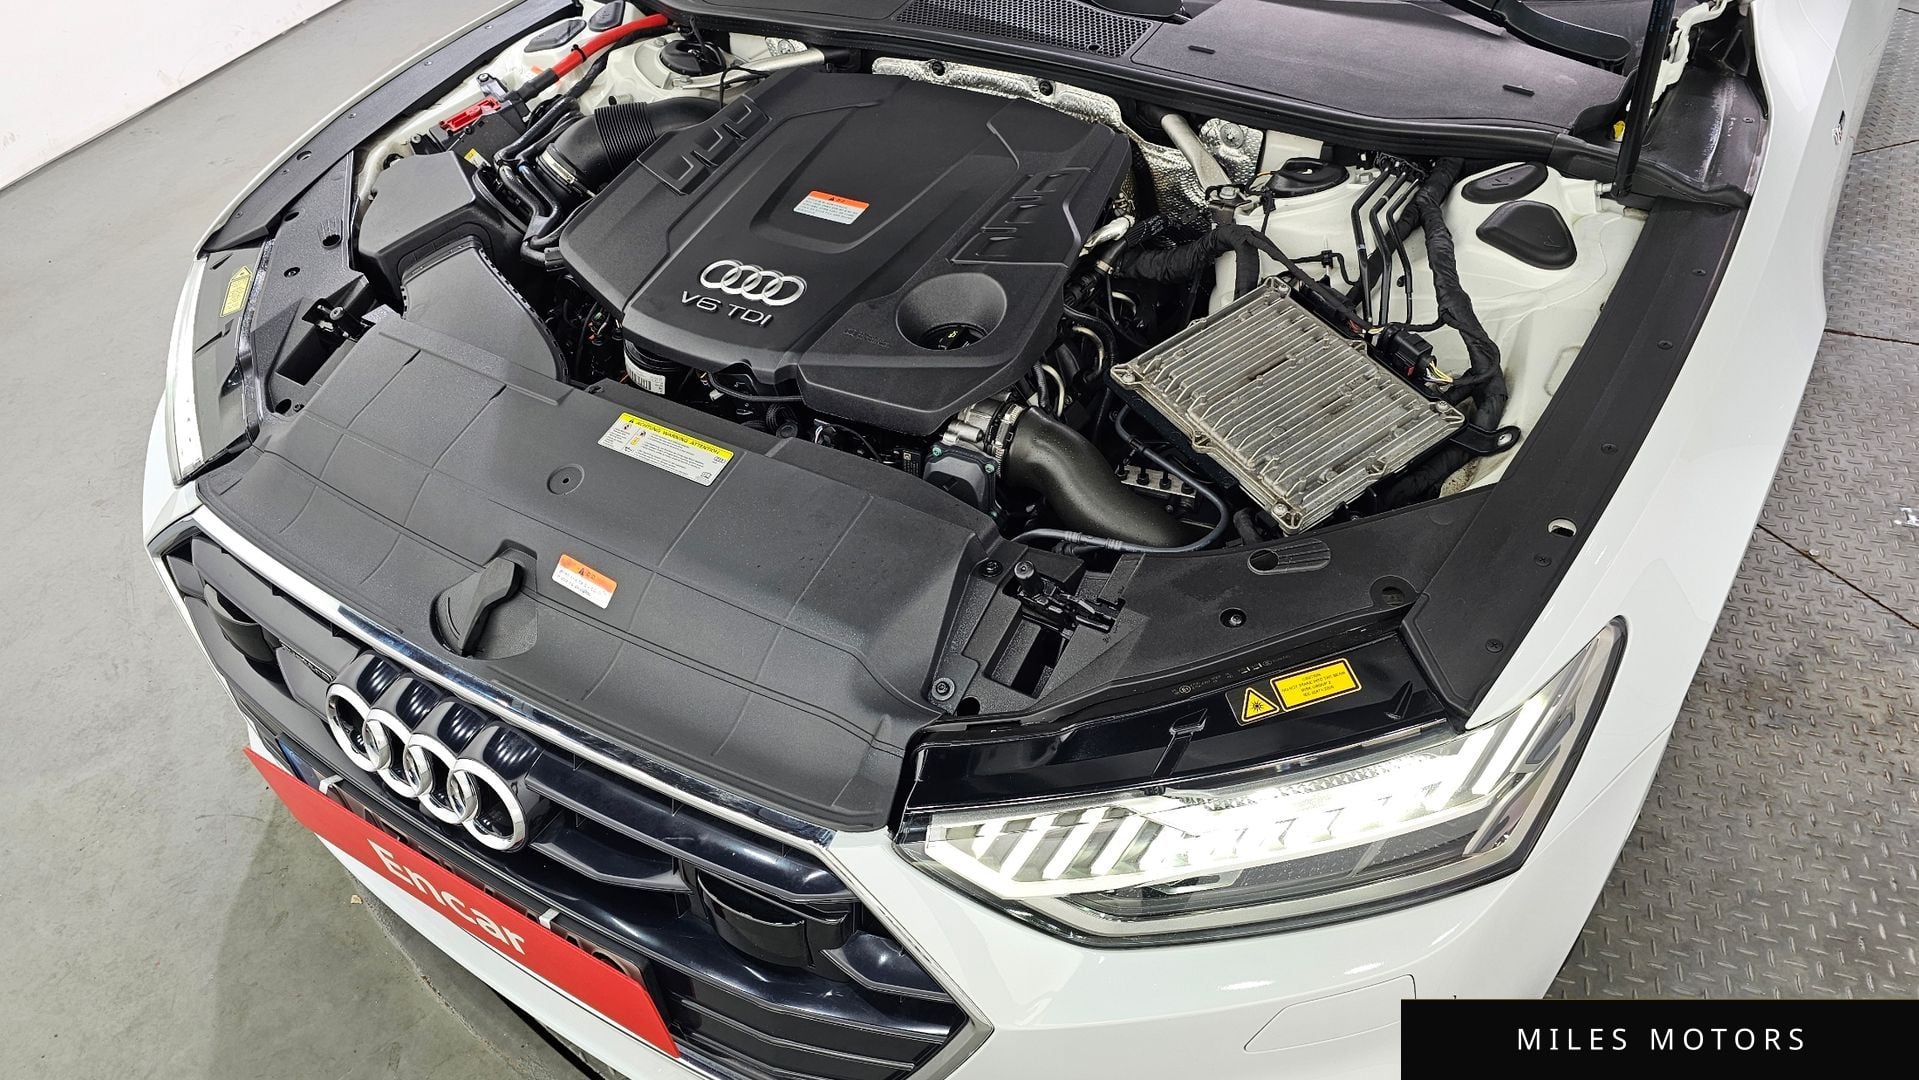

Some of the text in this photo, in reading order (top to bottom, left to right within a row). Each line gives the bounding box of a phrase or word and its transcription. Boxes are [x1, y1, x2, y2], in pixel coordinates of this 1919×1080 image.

[681, 290, 773, 327] V6 TDI
[662, 430, 689, 444] WARNING
[690, 440, 721, 455] ATTENTION
[367, 838, 526, 956] Encar
